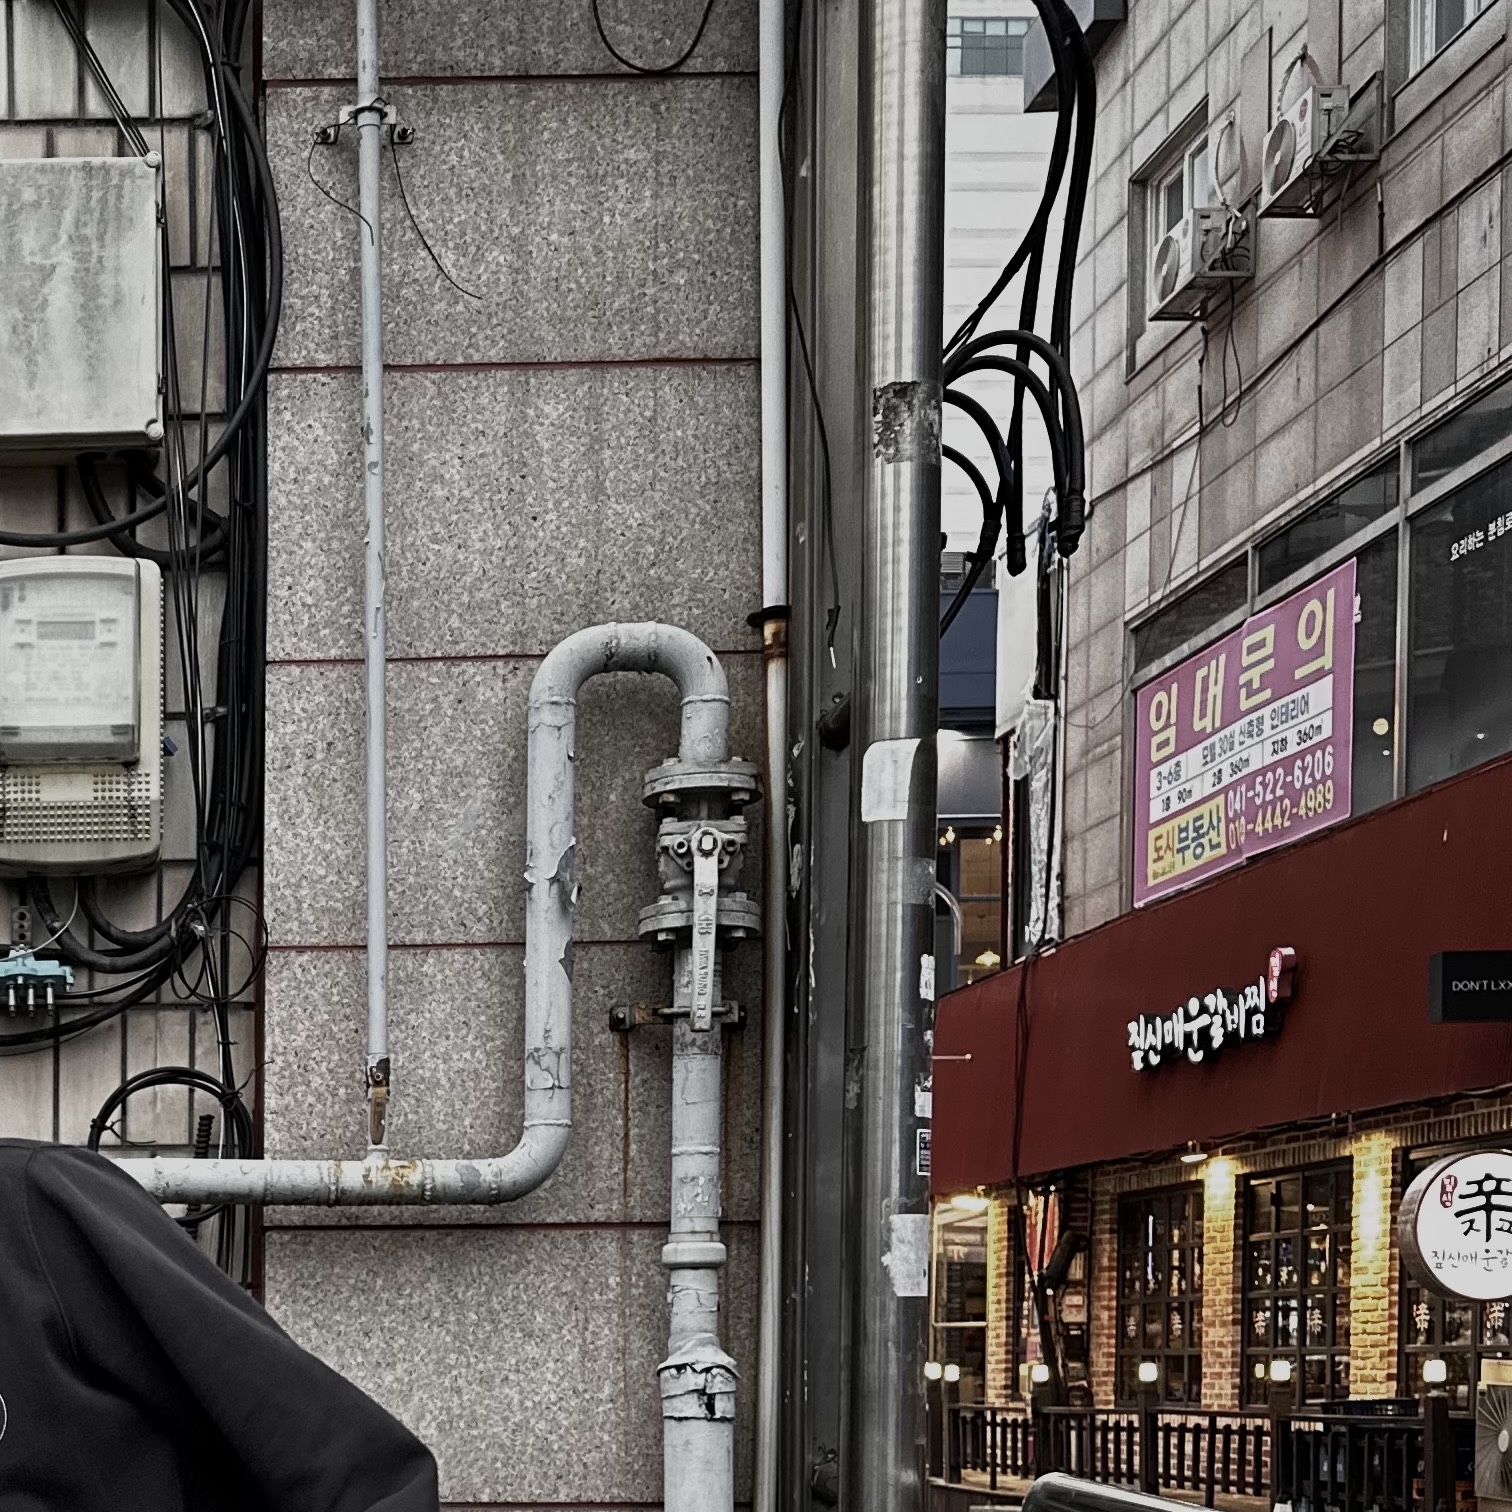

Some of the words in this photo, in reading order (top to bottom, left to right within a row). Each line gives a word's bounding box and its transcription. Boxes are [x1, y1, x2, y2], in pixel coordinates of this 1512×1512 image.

[1450, 529, 1484, 562] 요리하는
[1270, 692, 1310, 731] 인테리어
[1227, 744, 1334, 818] 041-522-6206
